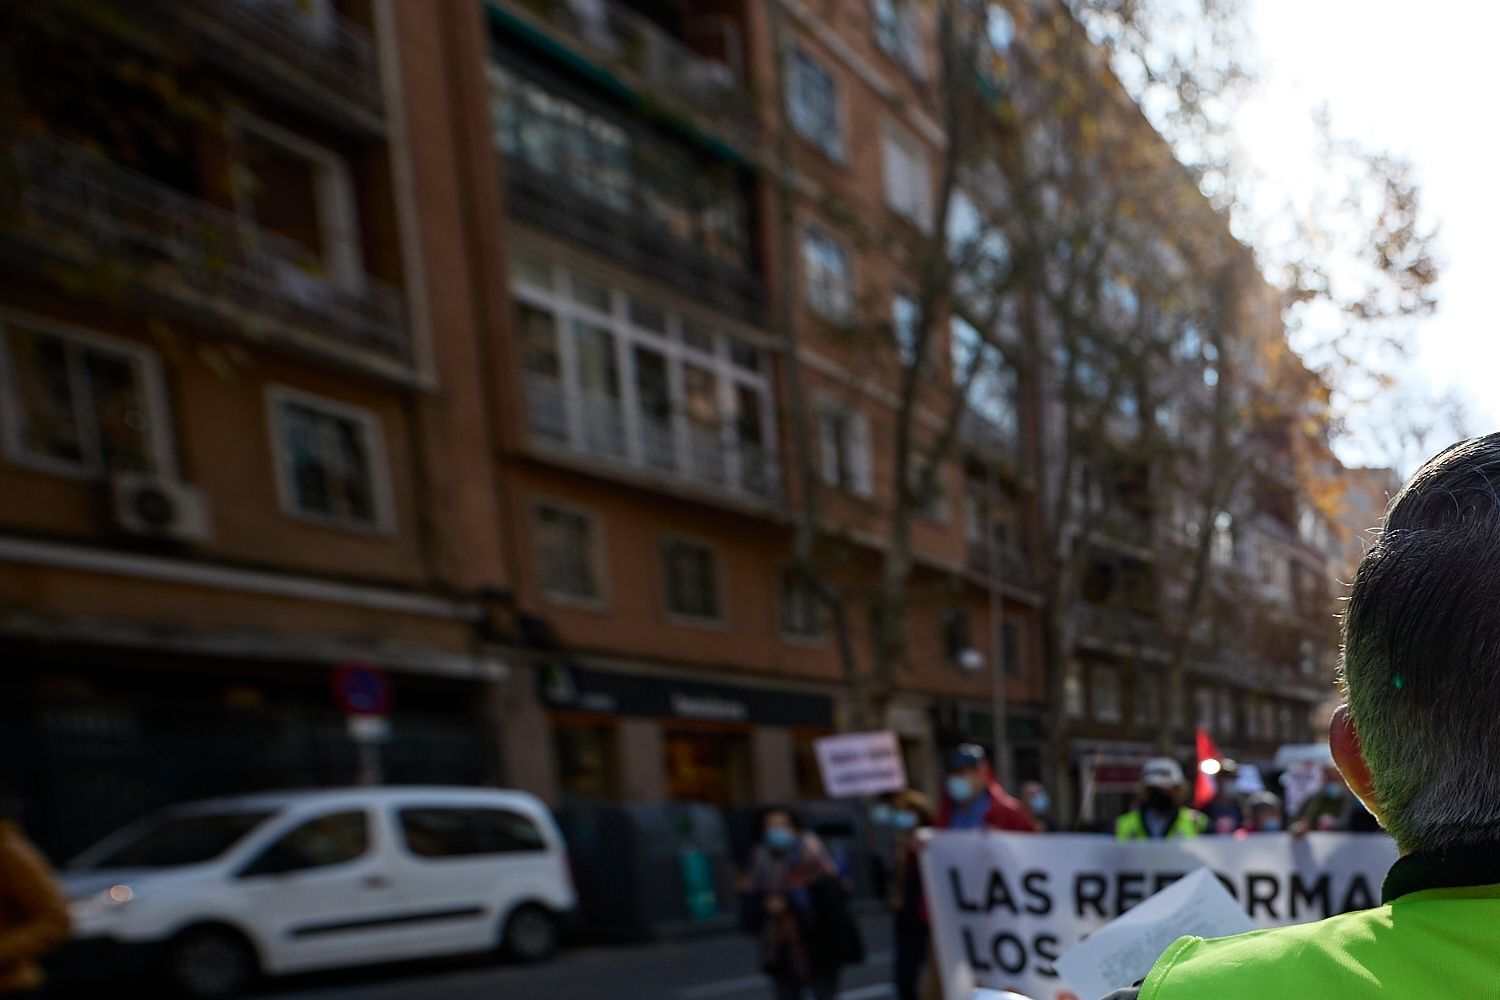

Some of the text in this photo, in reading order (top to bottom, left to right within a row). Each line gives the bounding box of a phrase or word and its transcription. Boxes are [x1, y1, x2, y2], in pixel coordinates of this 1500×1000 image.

[949, 867, 1053, 917] LAS
[1073, 871, 1387, 922] RERMA
[961, 922, 1060, 979] LOS
